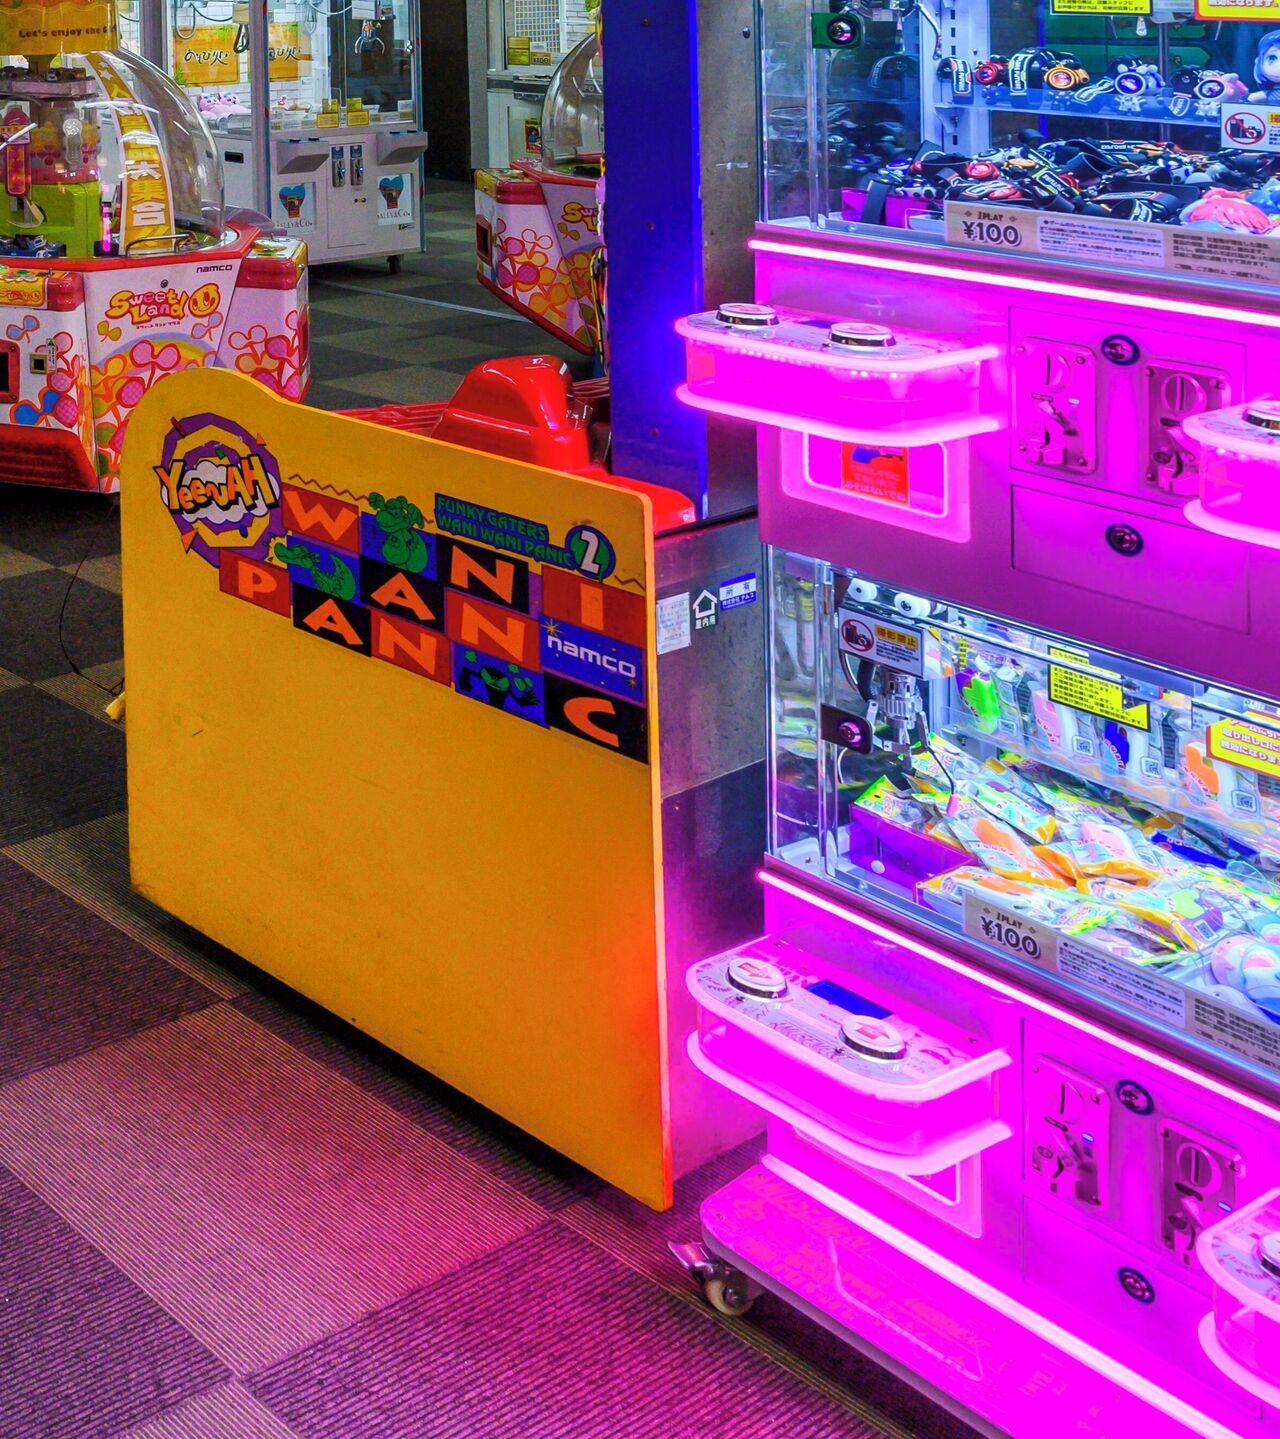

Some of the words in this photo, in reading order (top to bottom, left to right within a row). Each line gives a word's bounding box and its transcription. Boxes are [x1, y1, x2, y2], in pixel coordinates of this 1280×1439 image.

[962, 220, 1022, 247] ¥100
[196, 264, 233, 273] namco
[105, 287, 180, 318] Sweet
[130, 290, 189, 326] Land
[437, 495, 486, 523] FUNKY
[487, 509, 547, 542] GATERS
[437, 514, 478, 536] WANI
[479, 526, 521, 551] WANI
[524, 542, 576, 568] PANIC
[579, 529, 601, 575] 2
[545, 631, 638, 680] namco
[980, 915, 1041, 959] ¥100
